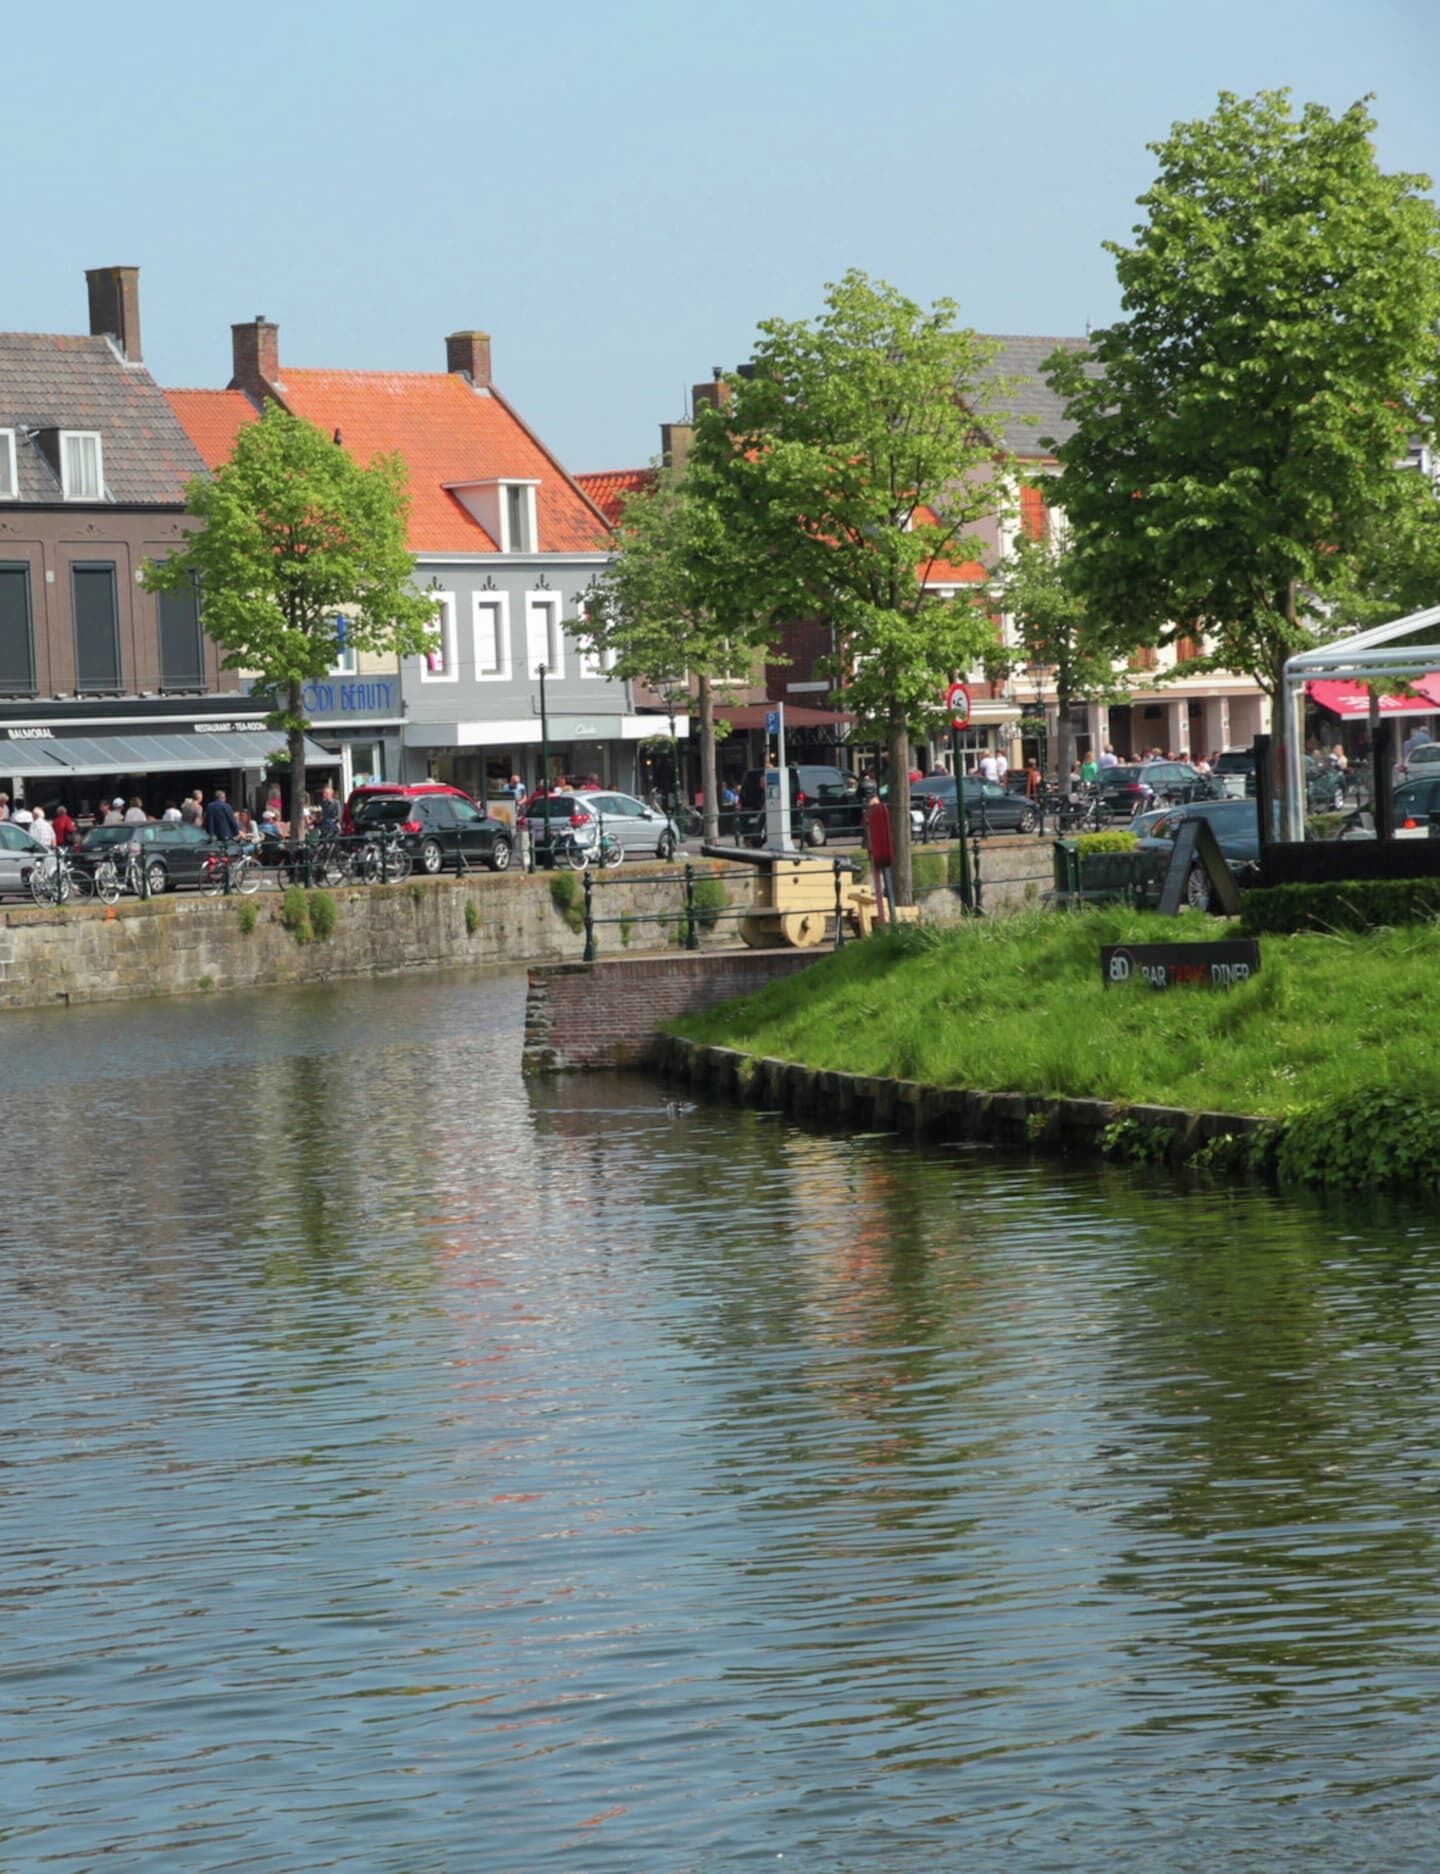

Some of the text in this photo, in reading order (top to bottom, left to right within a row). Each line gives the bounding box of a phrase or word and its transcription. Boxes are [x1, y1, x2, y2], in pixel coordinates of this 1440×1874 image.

[341, 683, 394, 711] BEAUTY
[7, 727, 56, 740] BALMORAL
[1141, 965, 1167, 987] BAR
